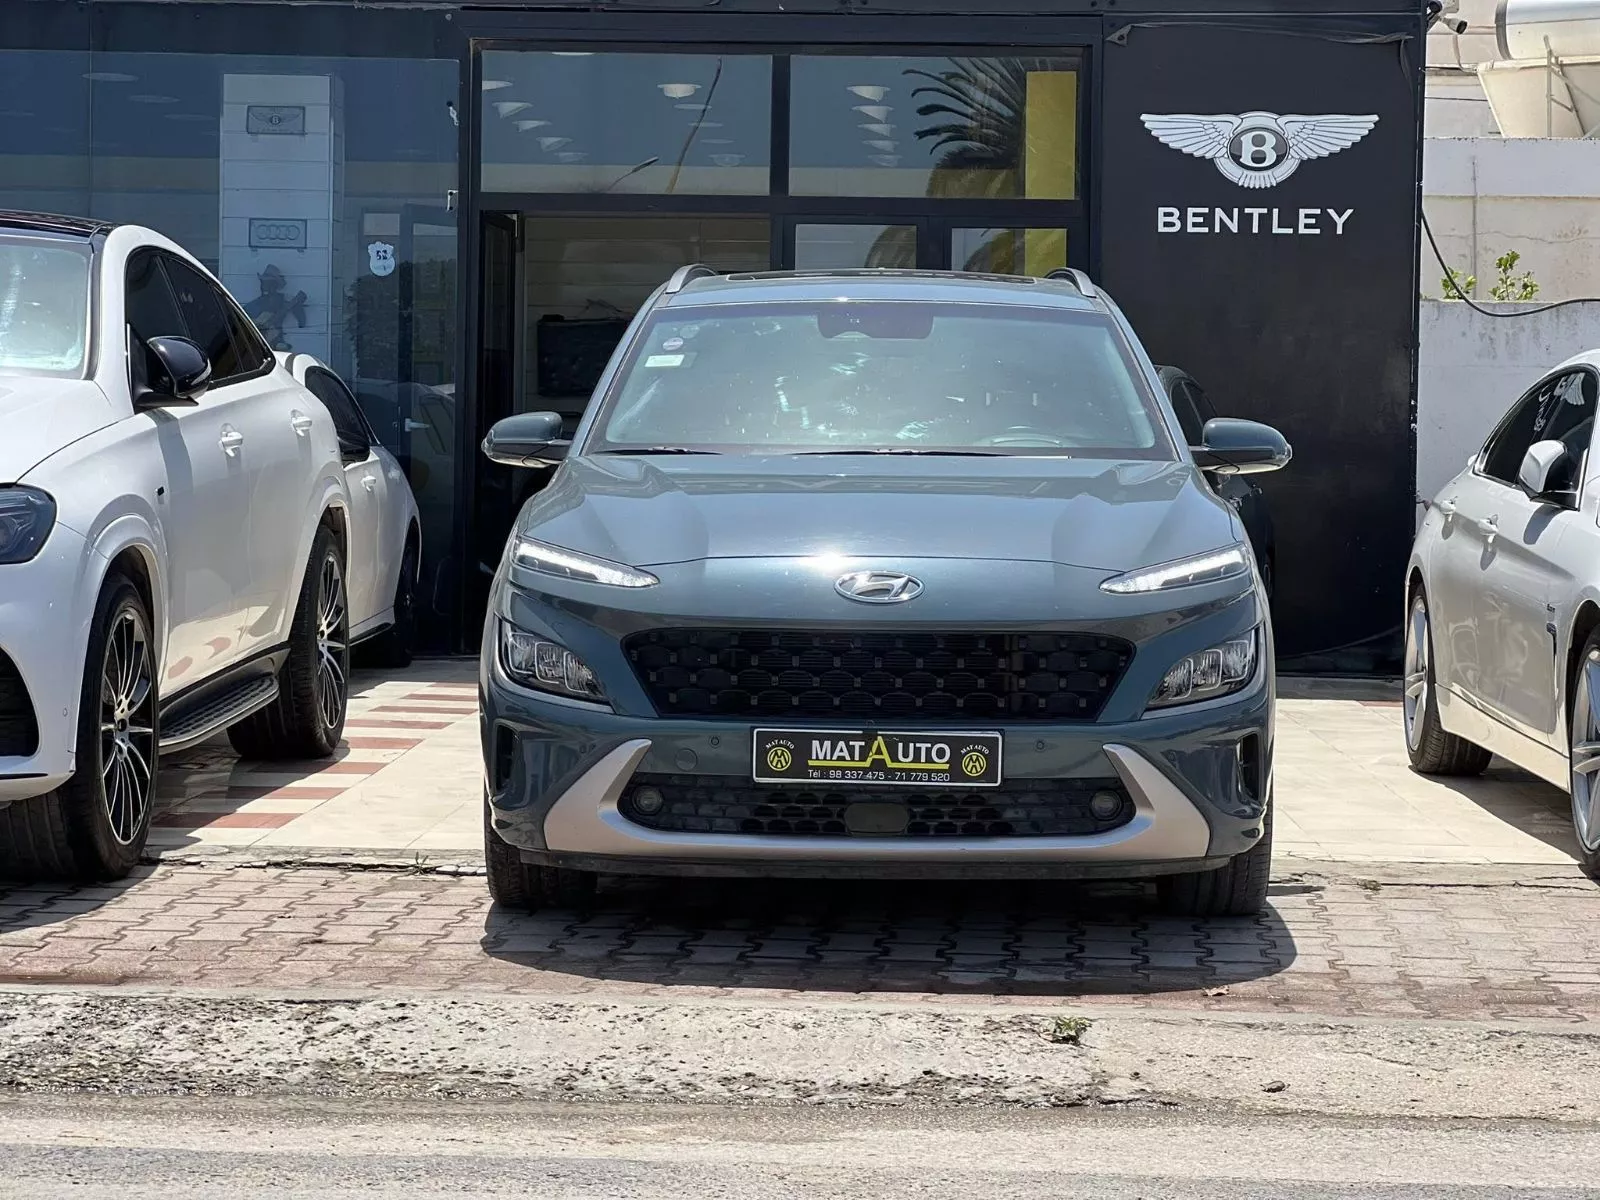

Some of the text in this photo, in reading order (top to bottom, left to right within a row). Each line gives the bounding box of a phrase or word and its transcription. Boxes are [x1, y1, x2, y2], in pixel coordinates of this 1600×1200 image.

[1239, 131, 1277, 168] B
[1157, 206, 1354, 234] BENTLEY
[829, 770, 842, 779] 98
[844, 770, 863, 779] 337
[866, 771, 885, 780] 475
[895, 772, 906, 780] 71
[910, 772, 929, 781] 779
[931, 773, 950, 782] 520
